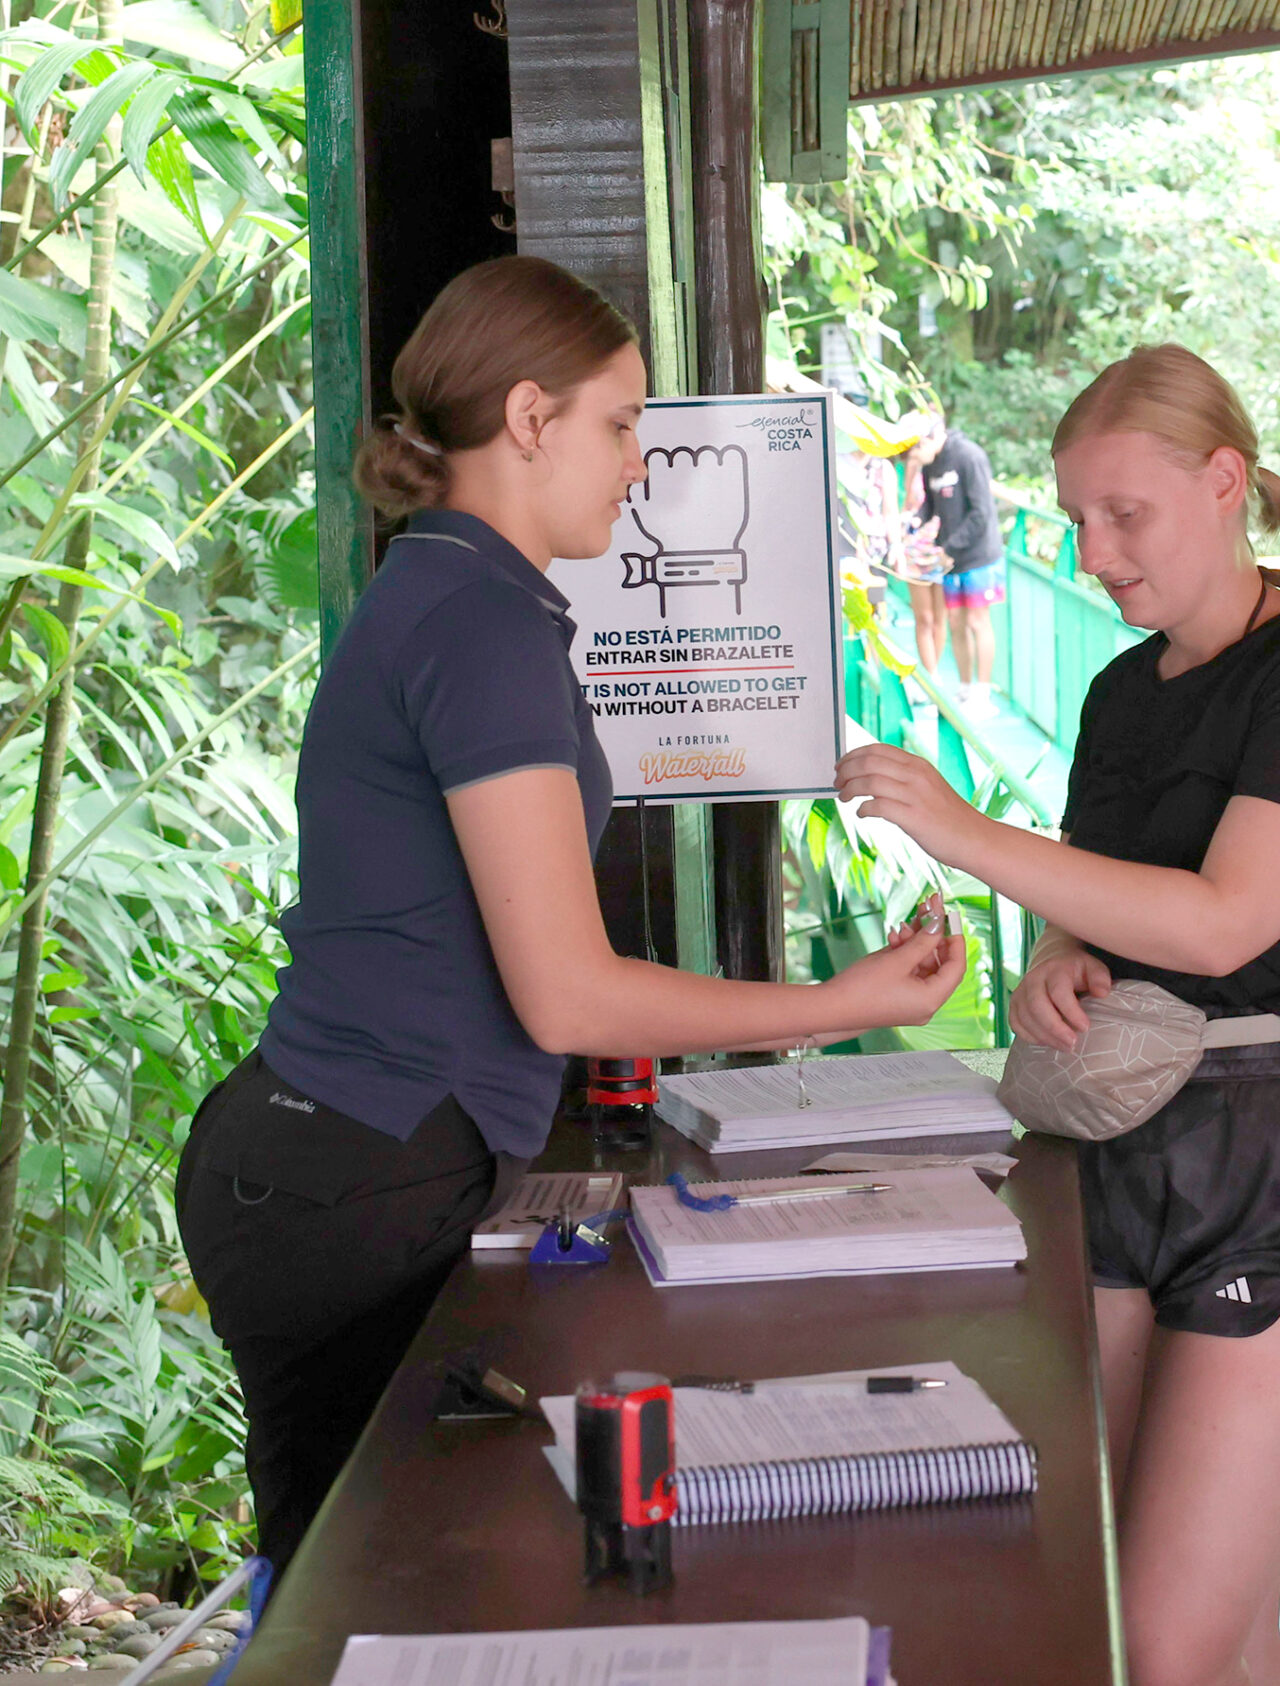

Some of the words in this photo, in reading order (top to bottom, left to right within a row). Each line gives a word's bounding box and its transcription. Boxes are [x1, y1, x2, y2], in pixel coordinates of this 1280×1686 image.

[736, 408, 817, 431] esencial
[767, 428, 813, 440] COSTA
[768, 440, 802, 452] RICA
[594, 631, 622, 647] NO
[625, 626, 674, 645] ESTÁ
[677, 625, 782, 644] PERMITIDO
[586, 649, 657, 666] ENTRAR
[660, 648, 689, 663] SIN
[691, 645, 794, 662] BRAZALETE
[594, 684, 611, 698] IS
[614, 682, 652, 697] NOT
[654, 679, 741, 696] ALLOWED
[744, 677, 769, 693] TO
[771, 676, 808, 692] GET
[604, 700, 688, 717] WITHOUT
[691, 700, 704, 714] A
[707, 695, 800, 713] BRACELET
[658, 736, 672, 747] LA
[677, 734, 730, 746] FORTUNA
[638, 748, 747, 785] Waterfall
